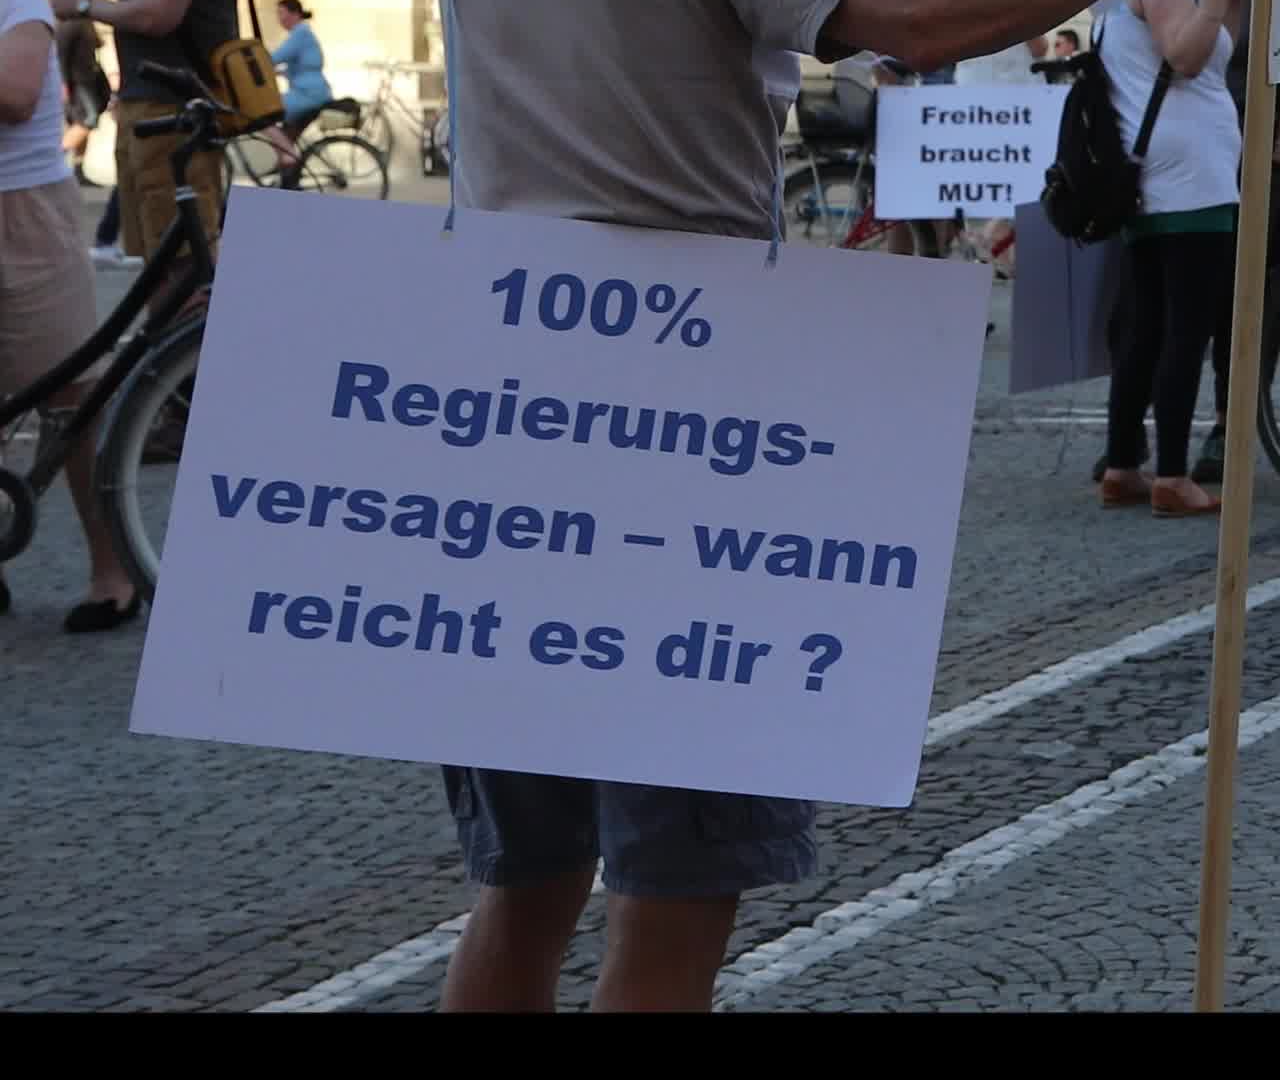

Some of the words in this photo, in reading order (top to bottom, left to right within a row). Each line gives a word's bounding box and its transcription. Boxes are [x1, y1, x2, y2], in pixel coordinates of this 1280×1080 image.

[919, 143, 1032, 164] braucht
[920, 105, 1033, 127] Freiheit
[937, 183, 1013, 204] MUT!
[490, 267, 713, 348] 100%
[330, 360, 836, 477] Regierungs-
[209, 473, 596, 560] versagen
[692, 524, 919, 589] wann
[247, 584, 502, 659] reicht
[528, 621, 626, 671] es
[655, 620, 771, 685] dir
[799, 633, 844, 692] ?
